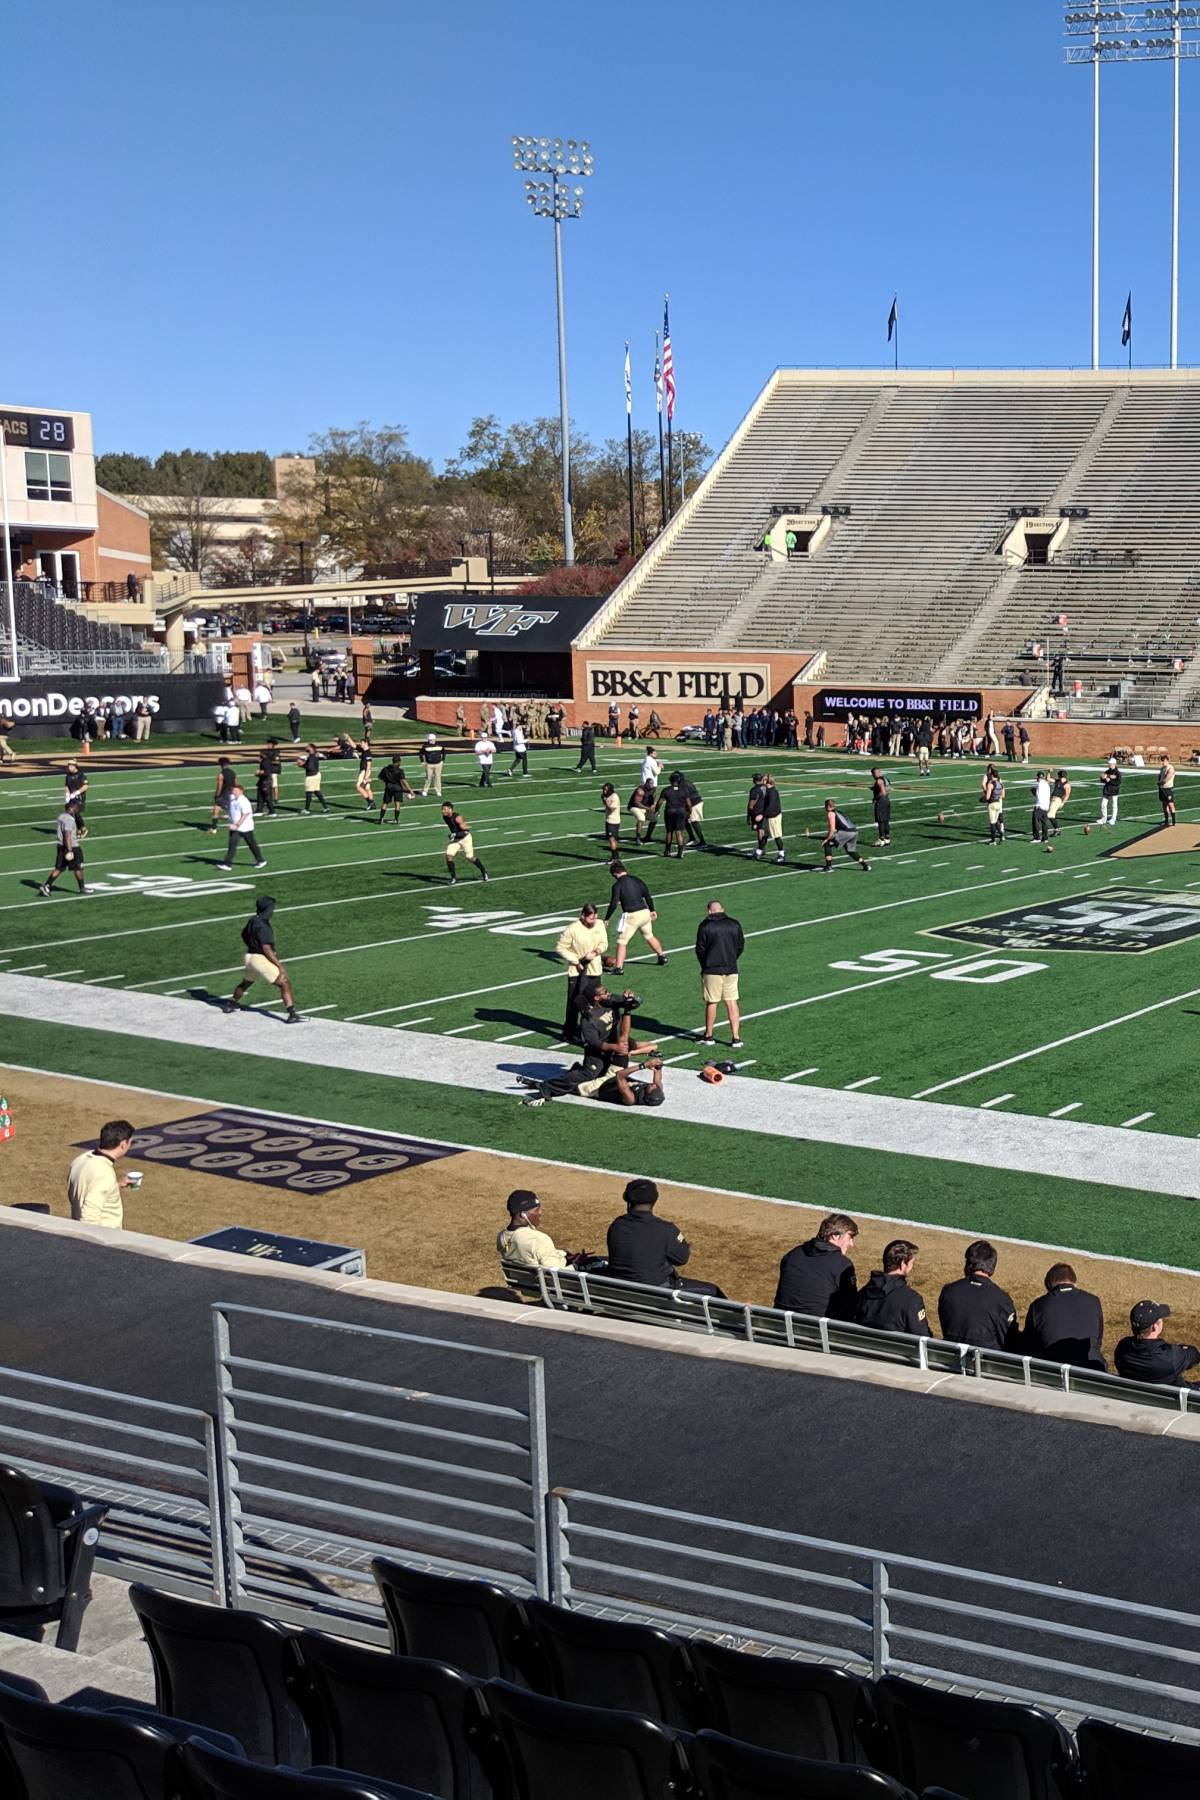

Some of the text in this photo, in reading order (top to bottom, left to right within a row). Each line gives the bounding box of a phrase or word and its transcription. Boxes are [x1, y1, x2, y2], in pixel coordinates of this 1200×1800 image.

[0, 419, 28, 435] ACS
[40, 420, 65, 442] 28
[444, 603, 559, 636] WF
[590, 670, 765, 700] BB&T FIELD
[824, 696, 978, 712] WELCOME TO BB&T FIELD
[84, 874, 257, 898] 30
[1001, 920, 1155, 939] YEARS
[1038, 933, 1149, 949] FIELD
[828, 948, 1051, 984] 50
[358, 1157, 398, 1166] 5
[294, 1172, 343, 1184] 10
